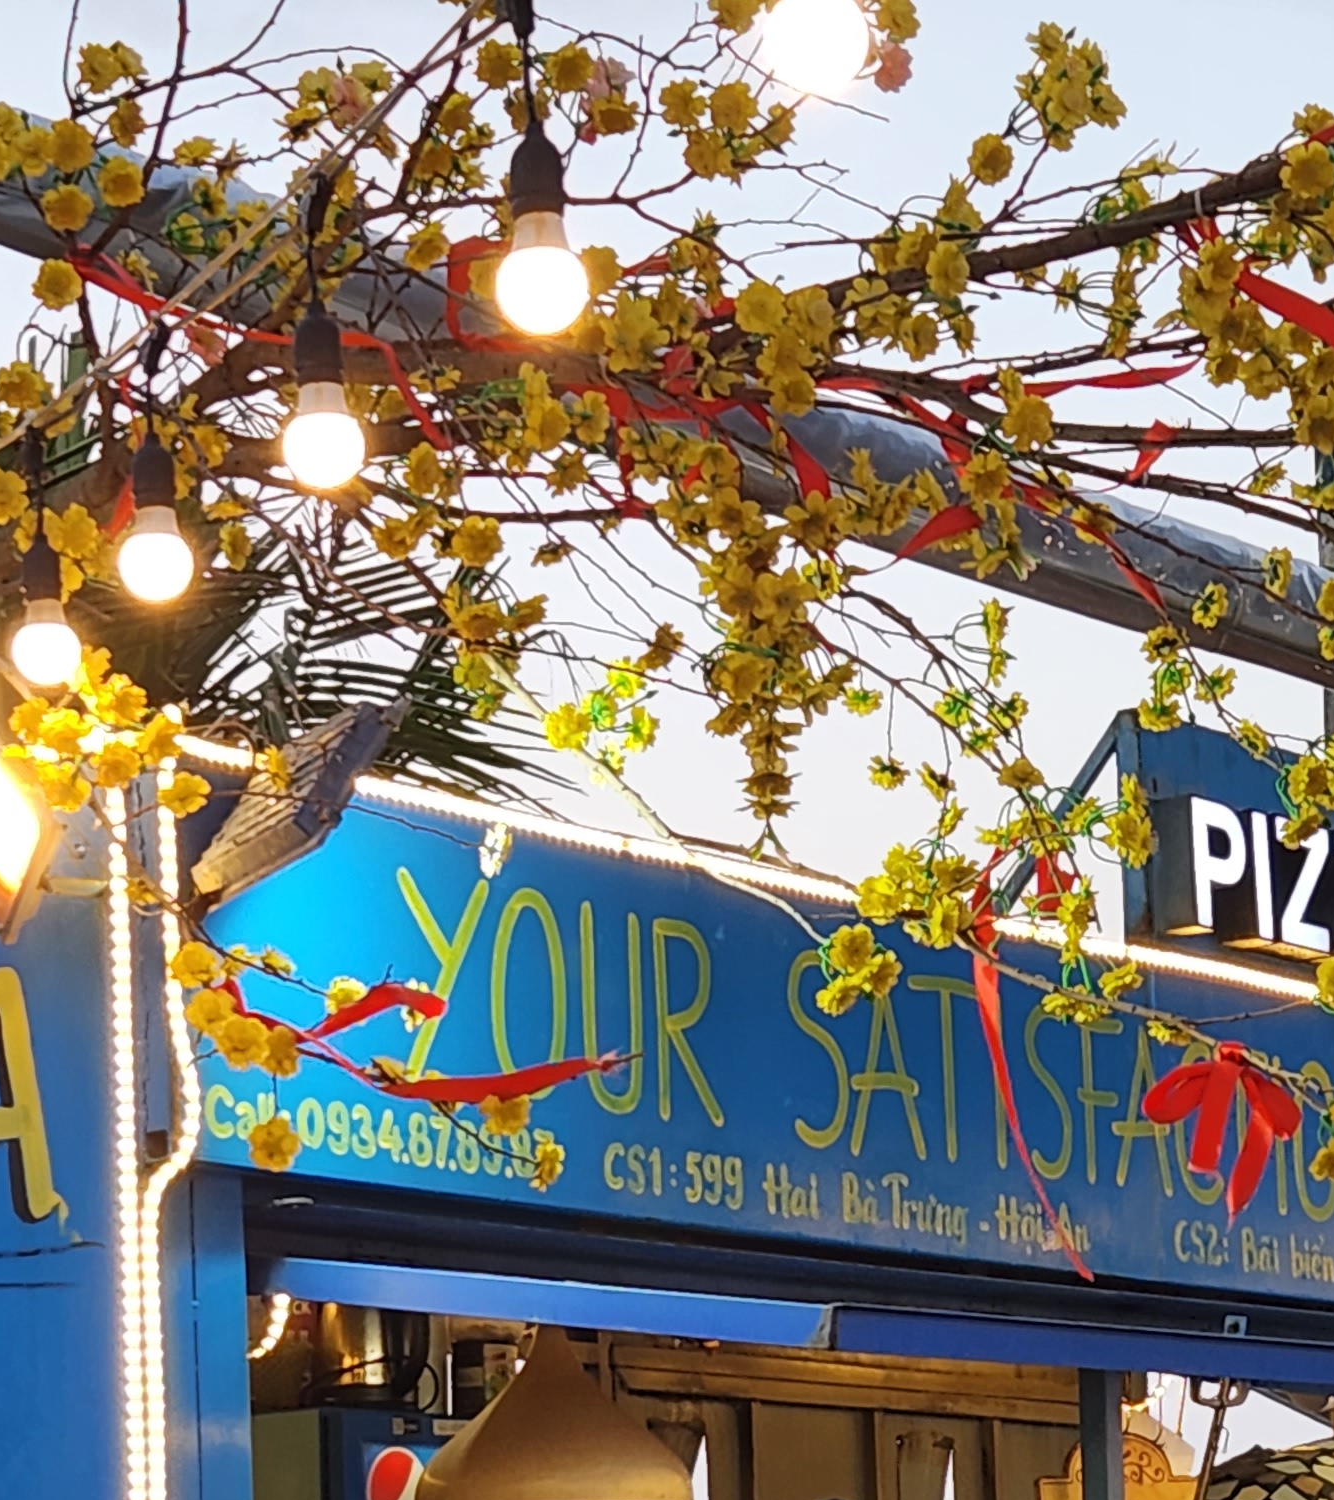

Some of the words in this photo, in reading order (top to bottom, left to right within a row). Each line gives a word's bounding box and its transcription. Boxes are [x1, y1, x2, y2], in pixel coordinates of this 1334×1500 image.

[396, 866, 725, 1128] YOUR
[684, 1151, 744, 1211] 599
[762, 1162, 820, 1221] Hai
[842, 1171, 880, 1225] Bà
[880, 1172, 969, 1247] Trưng
[993, 1193, 1044, 1256] Hội
[1053, 1201, 1092, 1253] An
